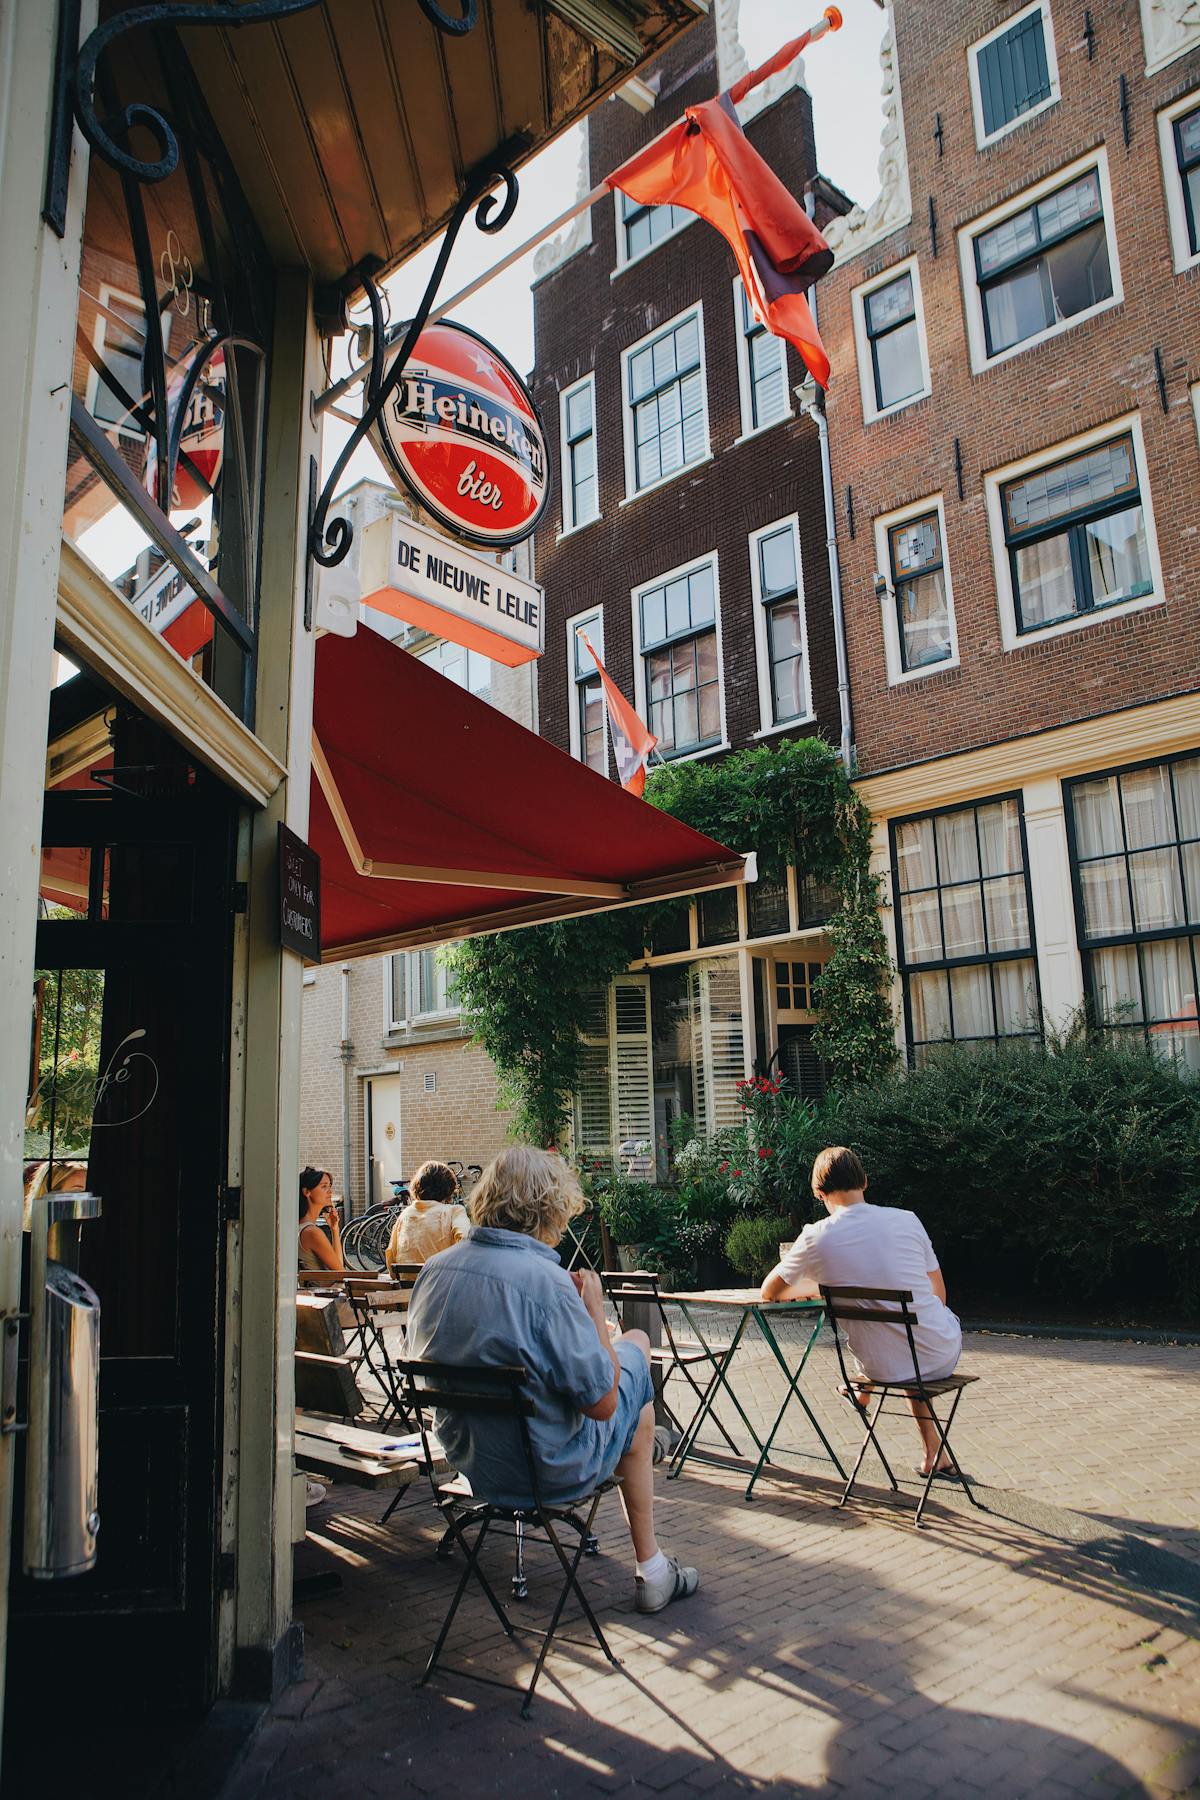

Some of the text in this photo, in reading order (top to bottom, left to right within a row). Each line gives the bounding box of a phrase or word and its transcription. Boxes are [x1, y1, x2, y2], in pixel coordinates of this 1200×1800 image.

[405, 380, 542, 473] Heineken
[456, 460, 503, 510] bier
[397, 540, 538, 628] DE NIEUWE LELIE
